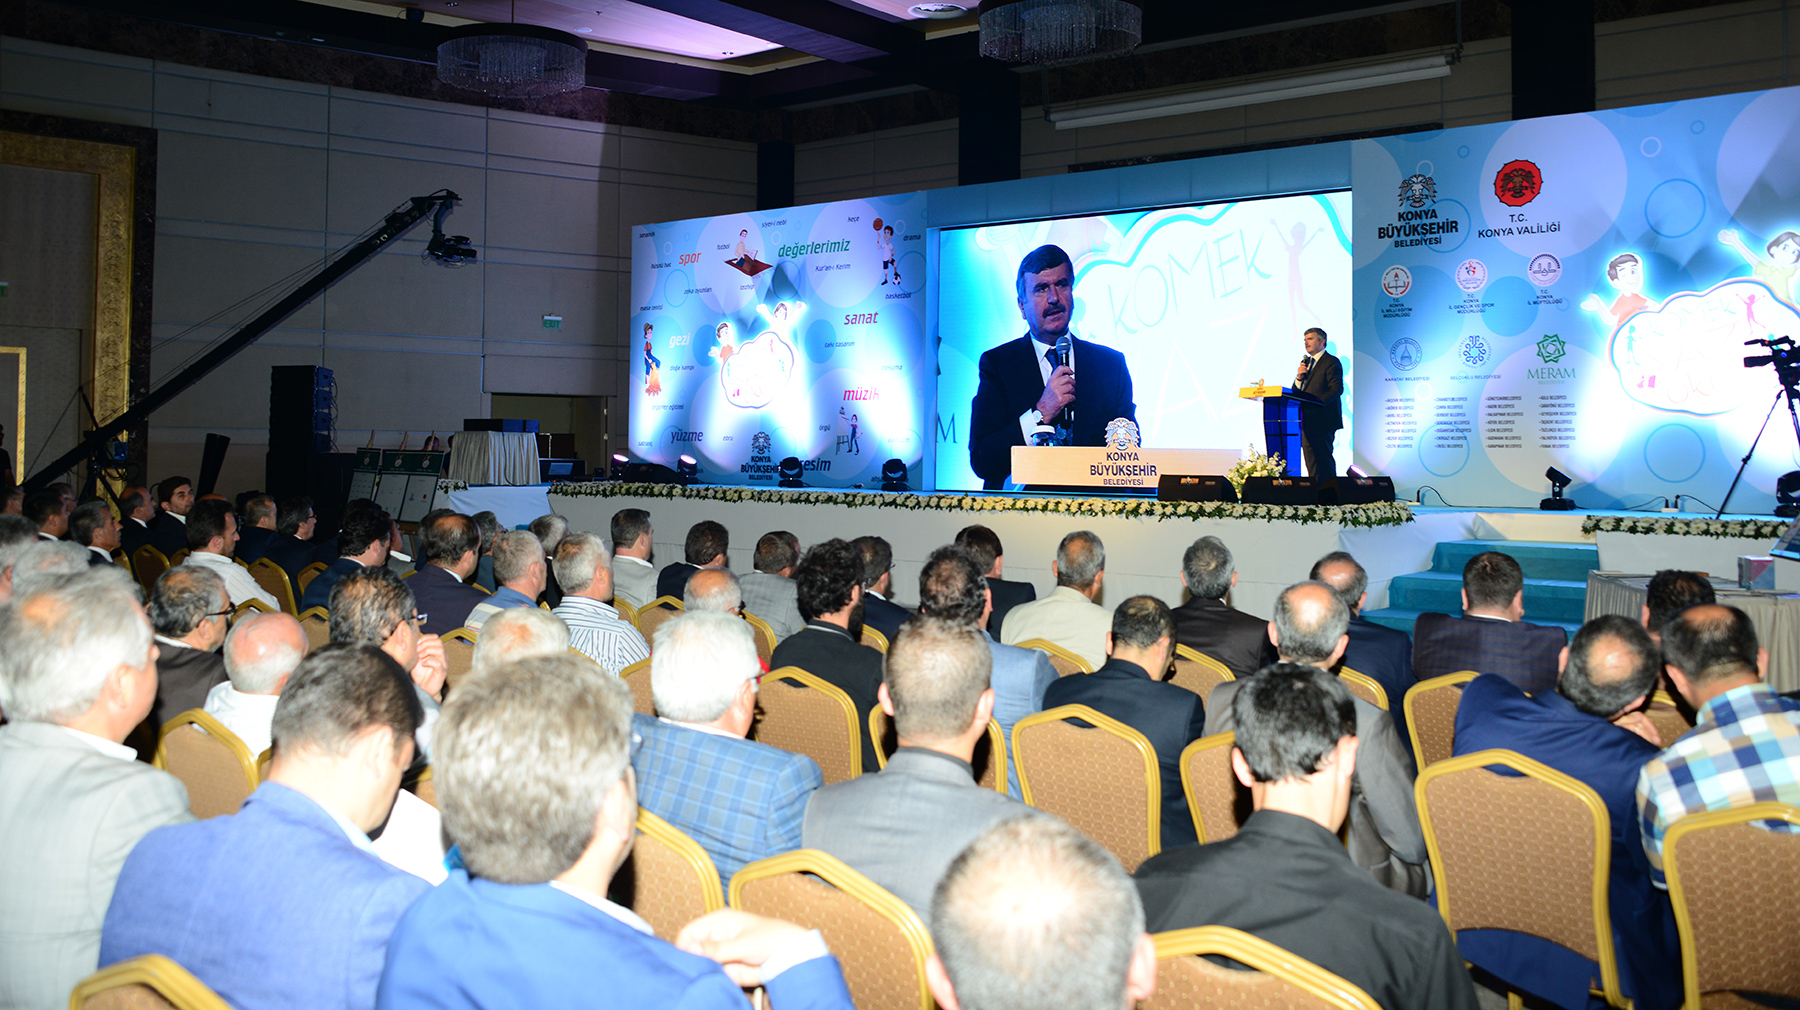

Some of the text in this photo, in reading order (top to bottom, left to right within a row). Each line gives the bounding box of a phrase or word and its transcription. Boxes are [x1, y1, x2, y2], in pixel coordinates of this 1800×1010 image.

[1397, 209, 1438, 222] KONYA
[1509, 213, 1528, 223] T.C.
[1378, 218, 1459, 240] BÜYÜKŞEHİR
[1478, 221, 1561, 239] KONYA VALİLİĞİ
[716, 243, 731, 251] futbol
[1394, 235, 1442, 248] BELEDİYESİ
[778, 238, 851, 259] değerlerimiz
[678, 253, 702, 267] spor
[885, 292, 912, 300] basketbol
[544, 319, 561, 328] EXIT
[844, 311, 879, 325] sanat
[669, 333, 691, 348] gezi
[1527, 367, 1577, 379] MERAM
[843, 387, 880, 401] müzik
[671, 429, 704, 444] yüzme
[1106, 452, 1139, 461] KONYA
[1090, 462, 1158, 477] BÜYÜKŞEHİR
[1103, 477, 1144, 486] BELEDİYESİ
